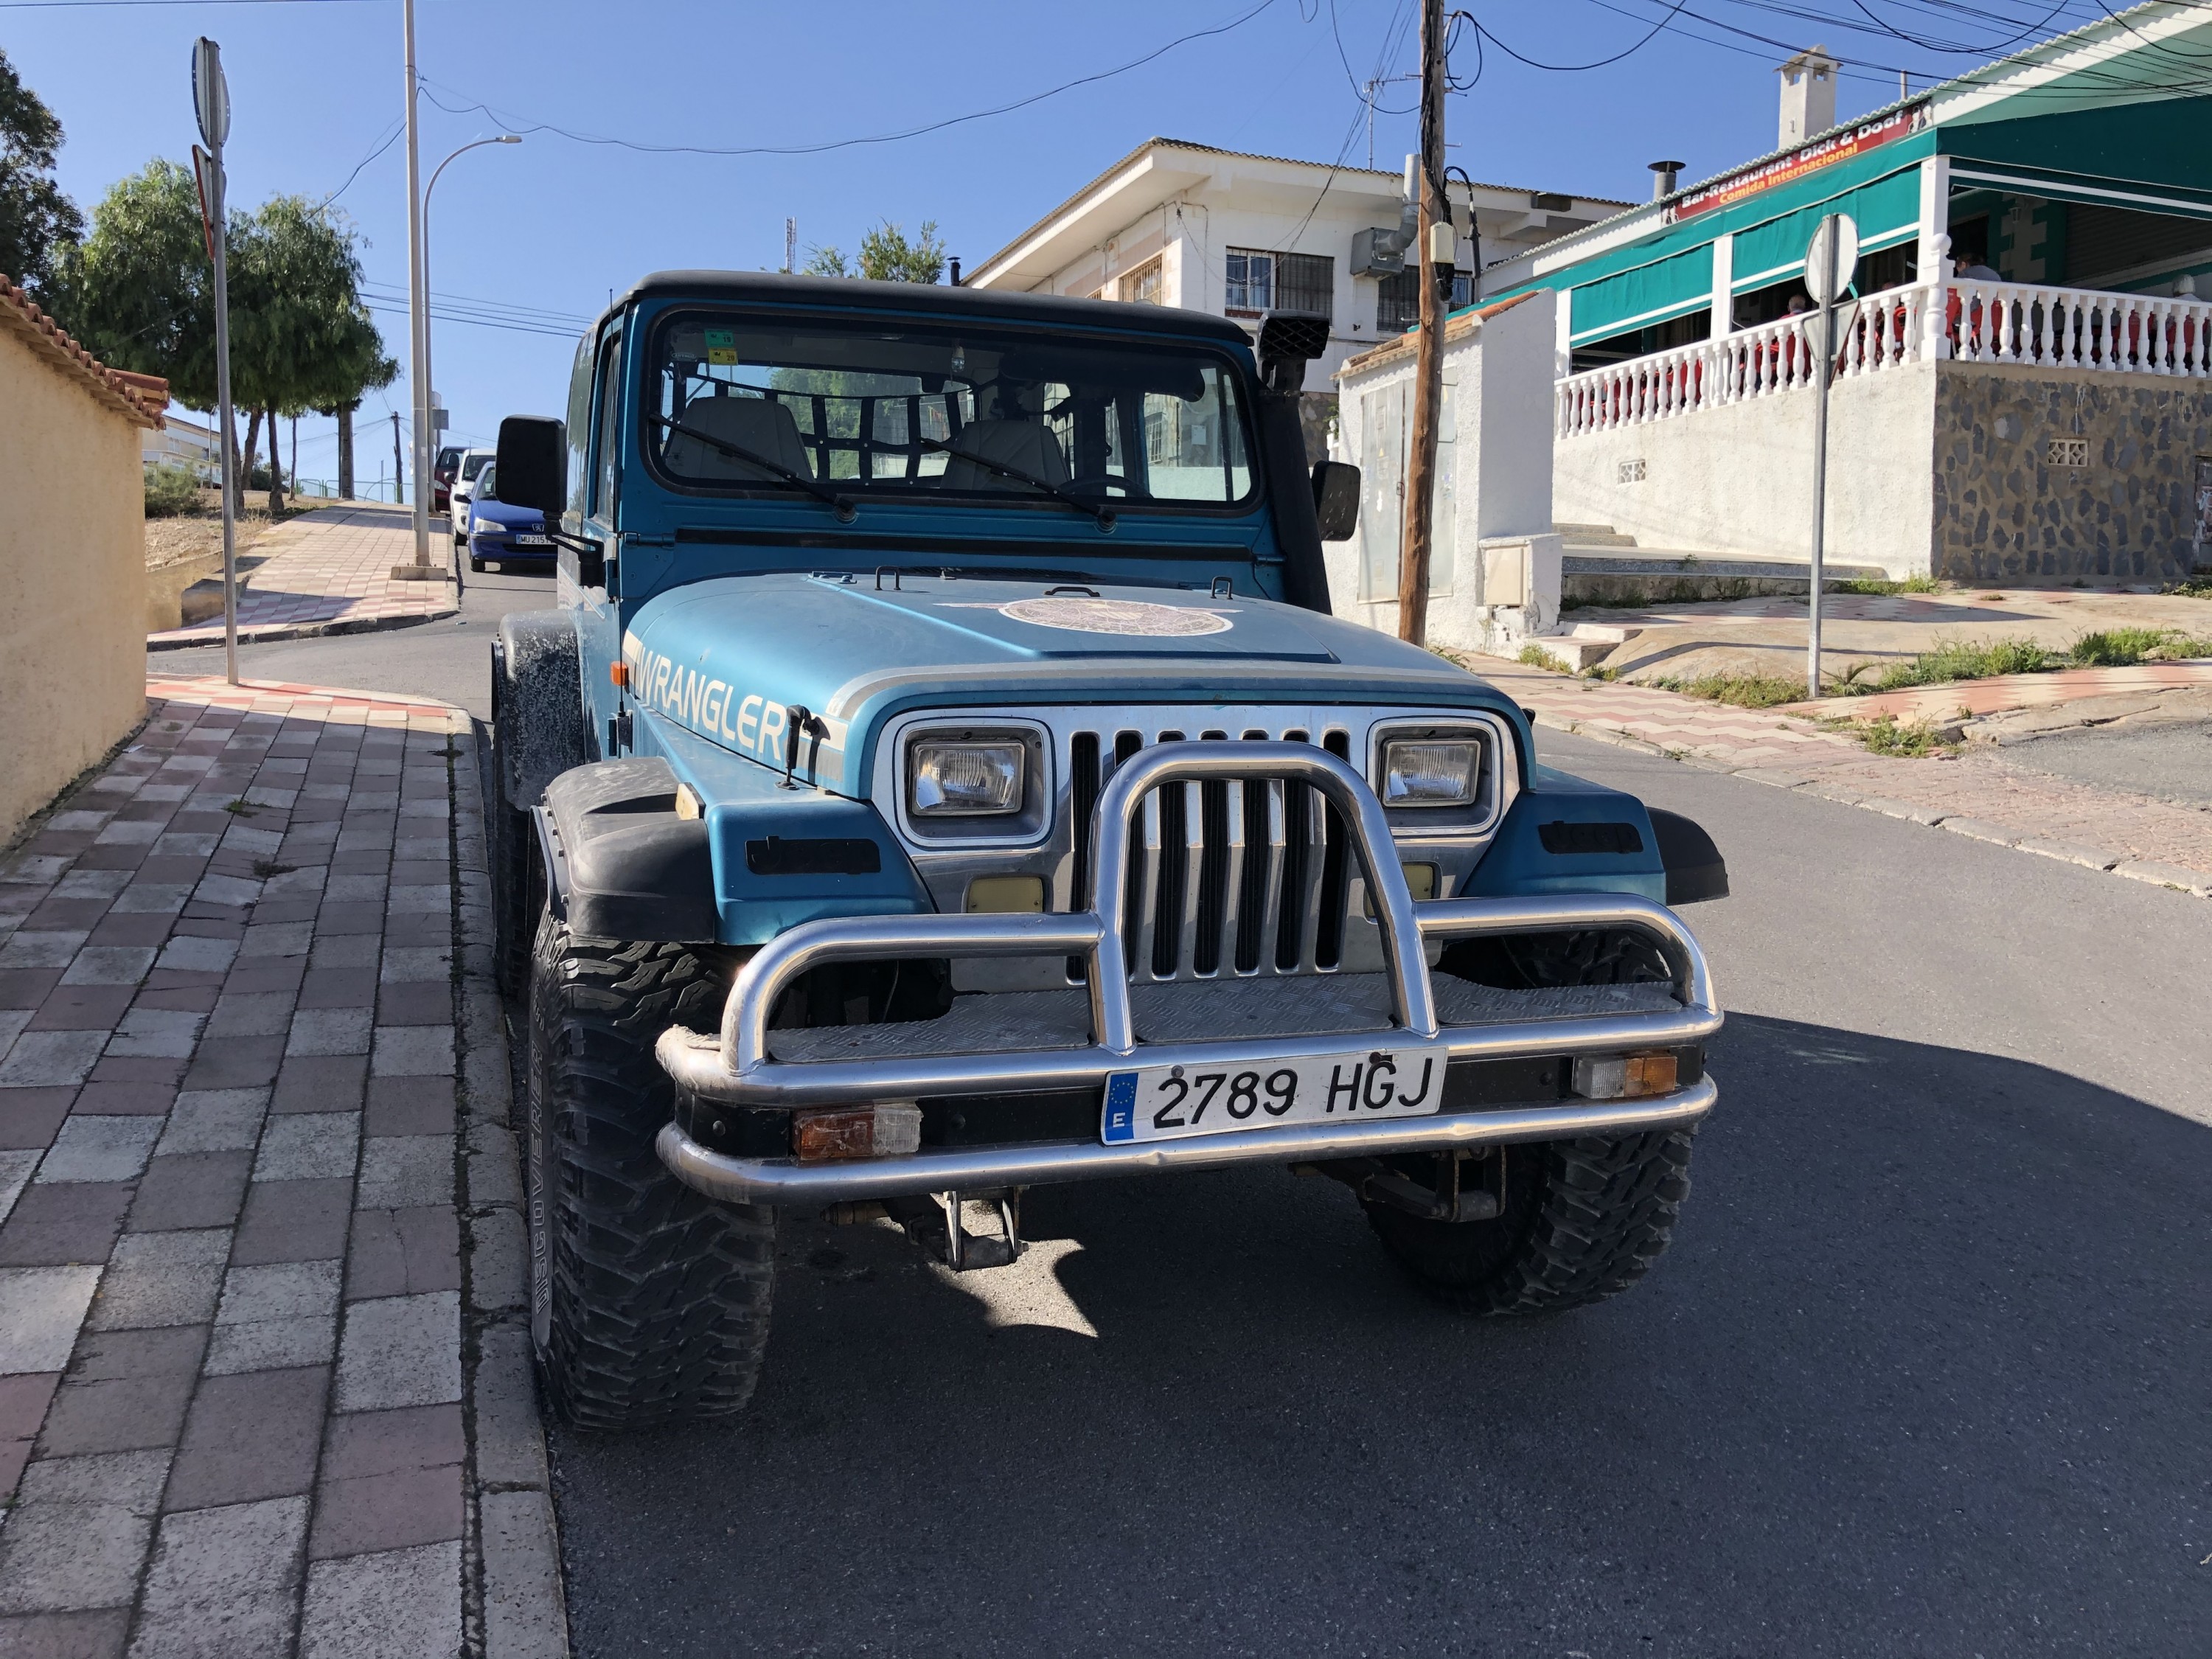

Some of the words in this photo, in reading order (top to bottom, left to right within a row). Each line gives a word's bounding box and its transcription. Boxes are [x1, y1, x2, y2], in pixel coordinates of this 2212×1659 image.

[1681, 156, 1792, 209] Bar-Restaurant
[1800, 138, 1837, 162] Dick
[1840, 131, 1854, 146] &
[1857, 110, 1904, 140] Doof
[1719, 180, 1765, 204] Comida
[1768, 142, 1858, 187] Internacional
[639, 647, 787, 761] WRANGLER
[1113, 1113, 1126, 1128] E
[1153, 1068, 1298, 1129] 2789
[1326, 1057, 1433, 1113] HGJ
[531, 1040, 549, 1315] DISCOVERER
